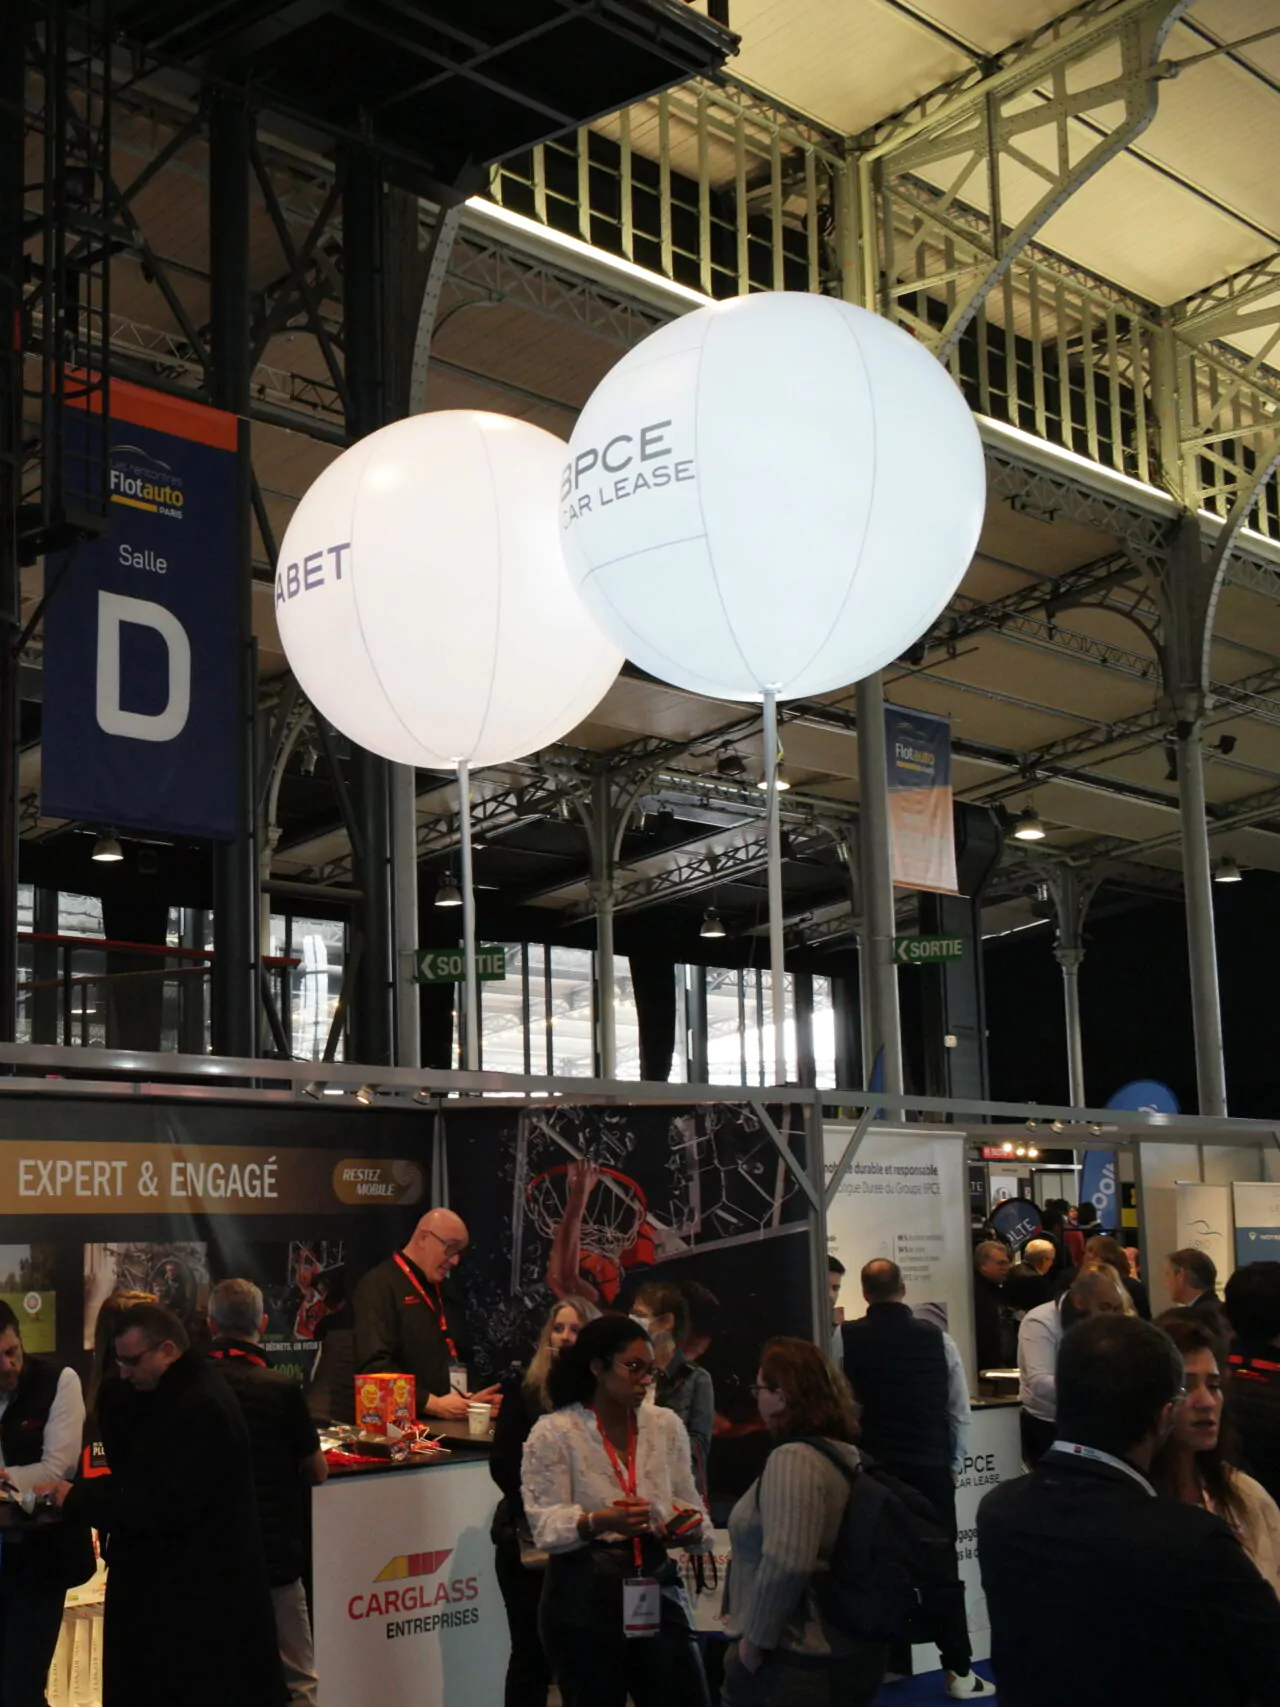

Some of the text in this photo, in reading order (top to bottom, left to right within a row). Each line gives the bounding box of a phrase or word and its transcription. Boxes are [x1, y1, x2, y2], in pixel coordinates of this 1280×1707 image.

[110, 469, 184, 507] Flotauto
[599, 459, 696, 506] LEASE
[159, 506, 183, 519] PARIS
[119, 544, 168, 574] Salle
[96, 589, 192, 742] D
[910, 939, 963, 957] SORTIE
[436, 954, 504, 975] SOTIE
[19, 1155, 279, 1198] EXPERT & ENGAGÉ
[343, 1168, 382, 1182] RESTEZ
[855, 1162, 883, 1175] durable
[894, 1163, 938, 1178] responsable
[355, 1183, 397, 1196] MOBILE
[973, 1473, 1000, 1487] LEASE
[348, 1577, 479, 1620] CARGLASS
[386, 1607, 479, 1639] ENTREPRISES
